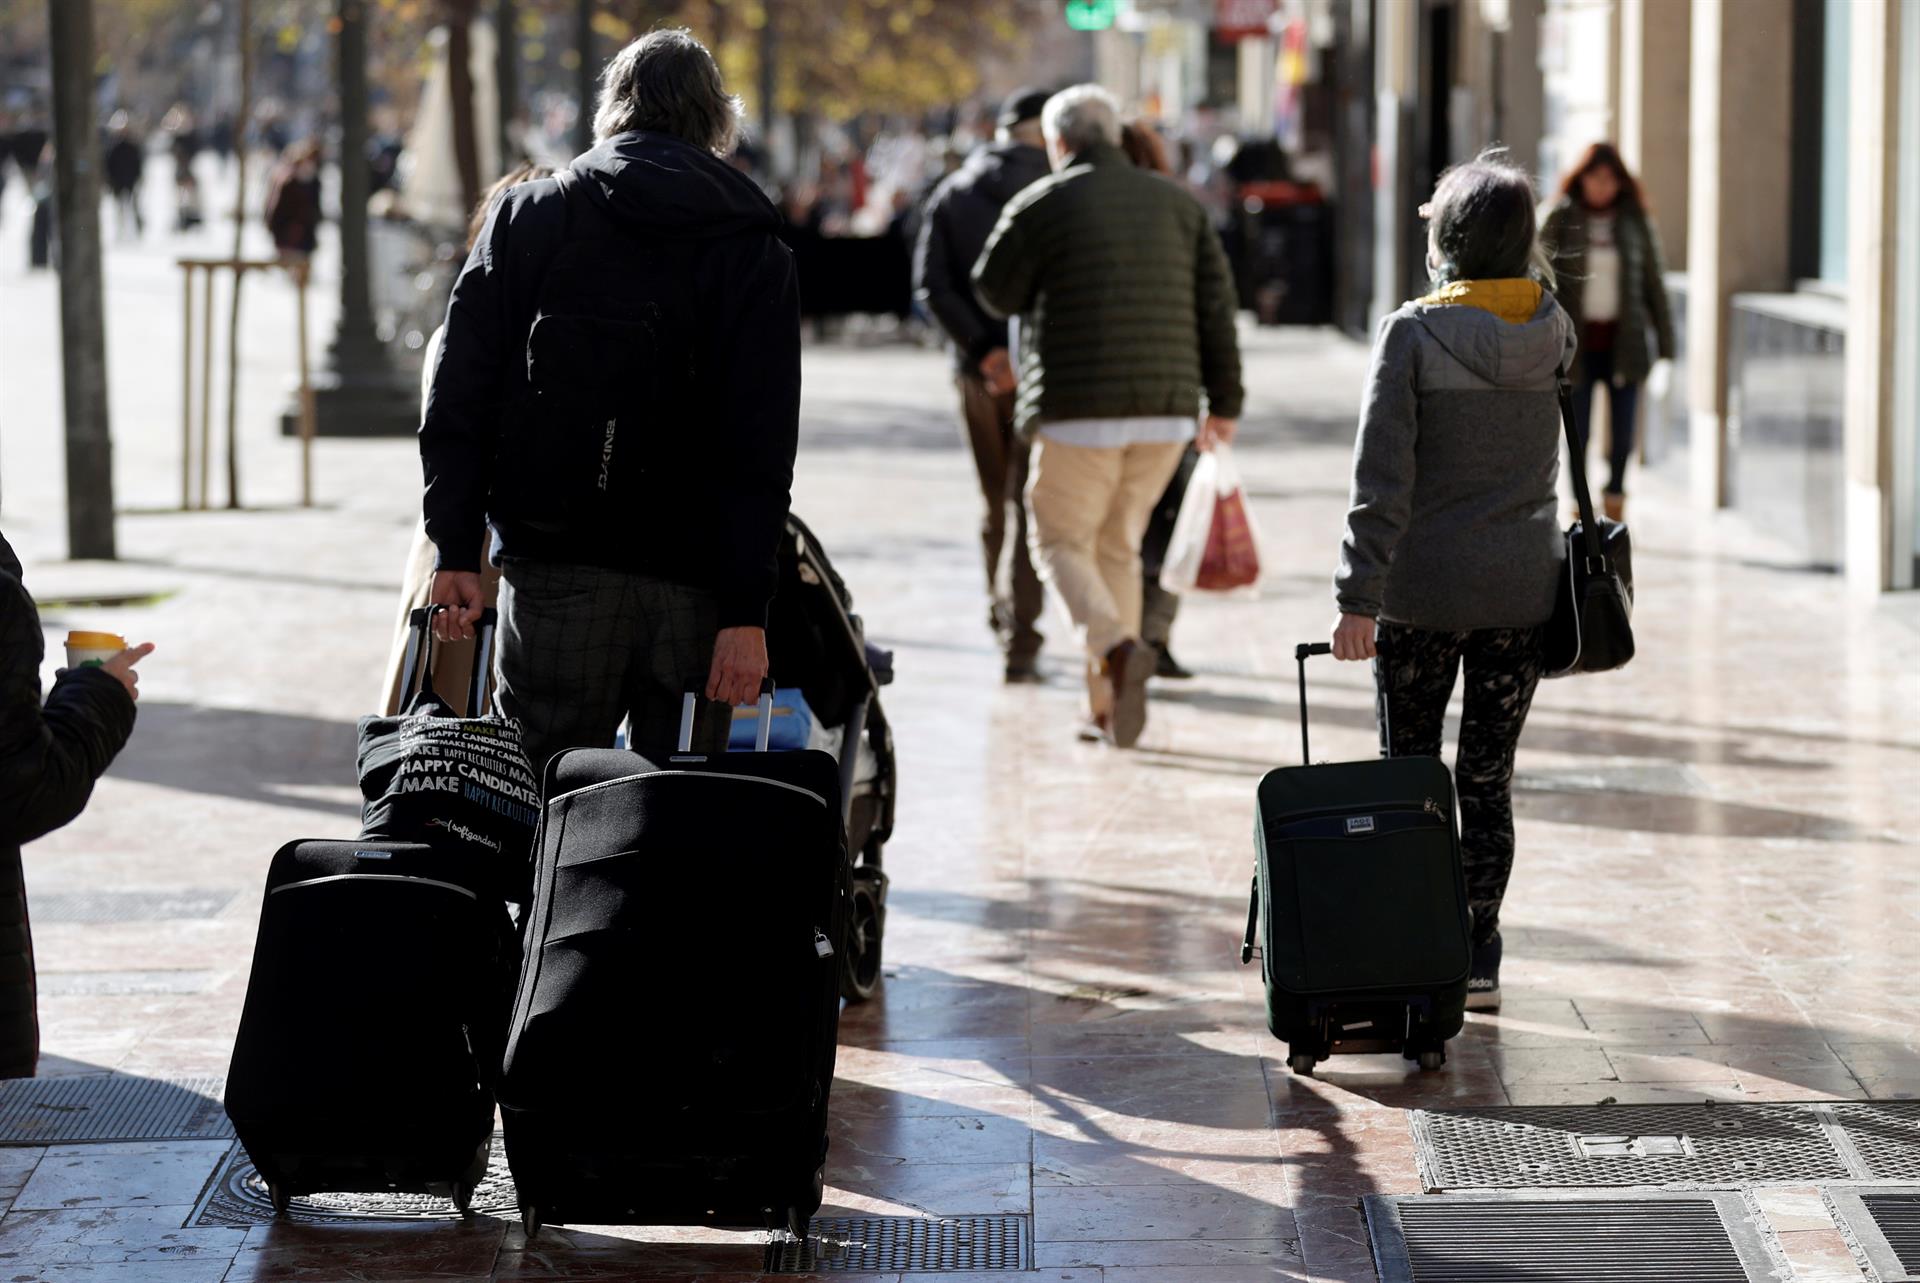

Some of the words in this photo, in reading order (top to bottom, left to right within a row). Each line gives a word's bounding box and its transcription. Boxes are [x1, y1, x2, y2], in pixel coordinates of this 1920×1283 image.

[598, 417, 617, 491] DAKINE
[400, 722, 461, 741] CANDIDATES
[463, 724, 497, 736] MAKE
[428, 730, 460, 738] HAPPY
[462, 733, 519, 752] CANDIDATES
[440, 739, 466, 748] MAKE
[467, 742, 496, 756] HAPPY
[444, 748, 467, 761] HAPPY
[468, 752, 508, 775] RECRUITERS
[401, 759, 454, 776] HAPPY
[458, 763, 543, 810] CANDIDATES
[402, 775, 460, 793] MAKE
[464, 782, 491, 809] HAPPY
